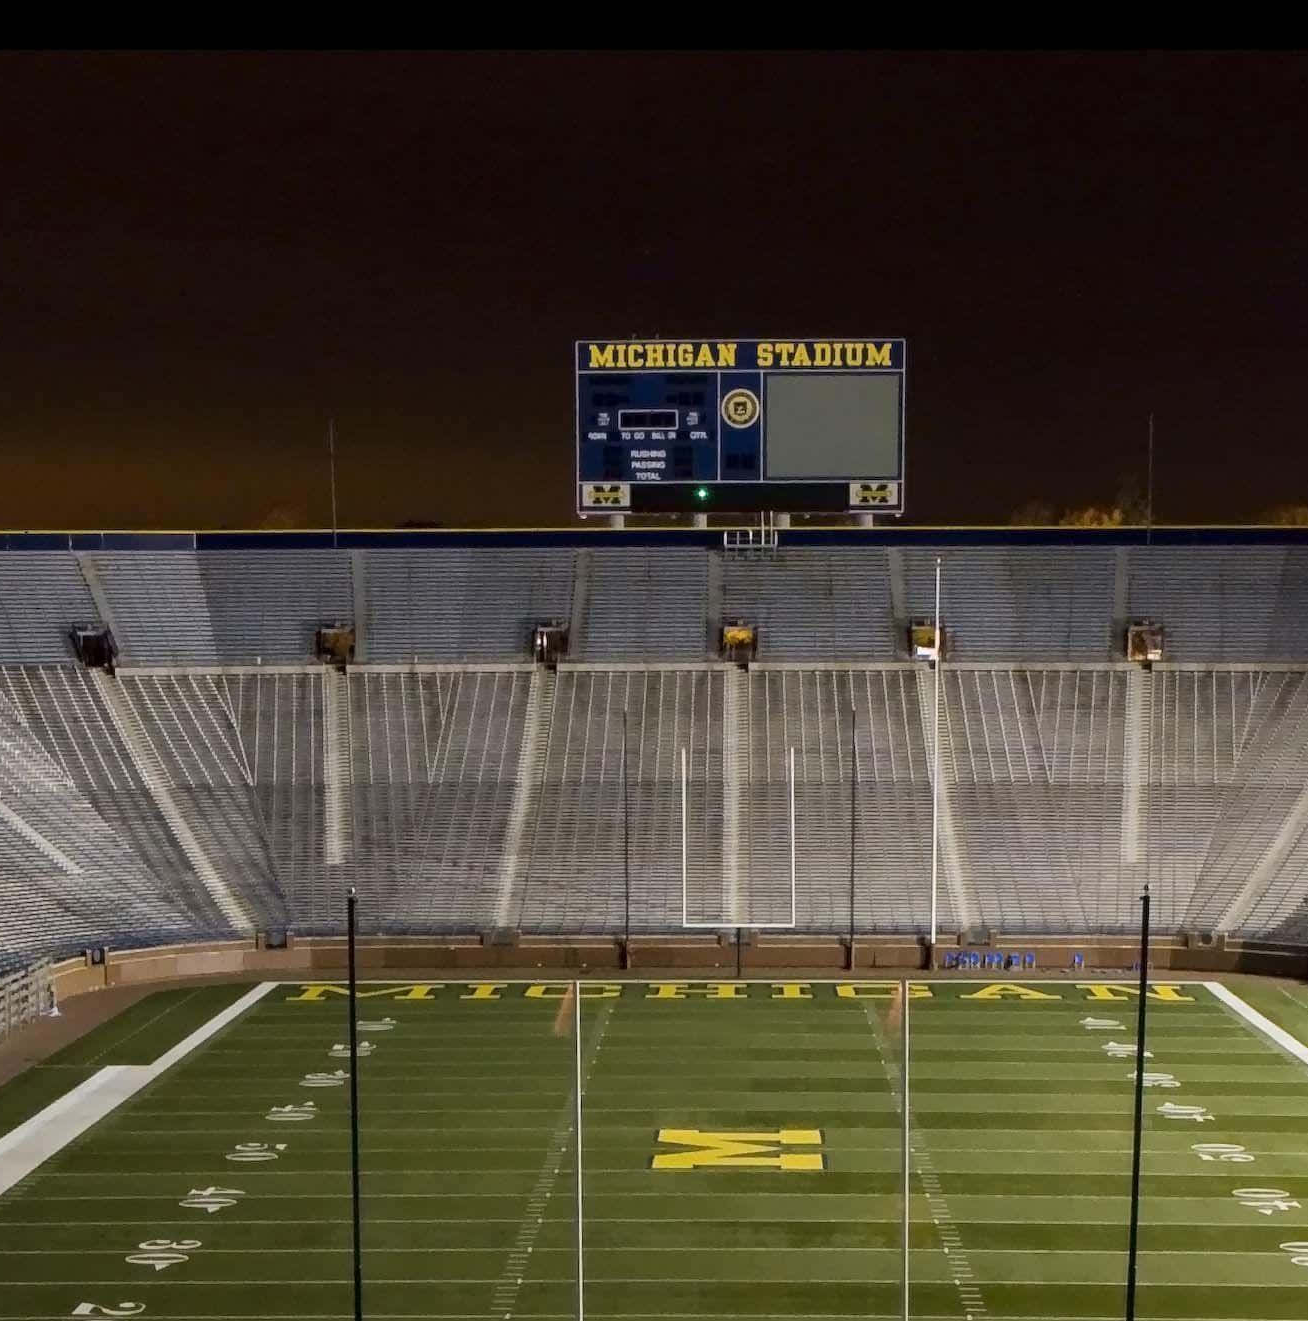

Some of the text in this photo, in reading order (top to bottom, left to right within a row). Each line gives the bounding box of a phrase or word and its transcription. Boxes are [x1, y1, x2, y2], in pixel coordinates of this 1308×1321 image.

[589, 343, 892, 368] MICHIGAN STADIUM
[621, 432, 631, 440] TO
[631, 450, 666, 458] RUSHING
[631, 461, 666, 469] PASSING
[635, 472, 661, 480] TOTAL
[285, 983, 1195, 1001] MICHIGAN
[225, 1143, 288, 1162] 50
[652, 1128, 824, 1170] M
[1191, 1143, 1255, 1162] 50
[179, 1187, 247, 1209] 40
[1232, 1188, 1302, 1212] 40
[125, 1240, 202, 1265] 30
